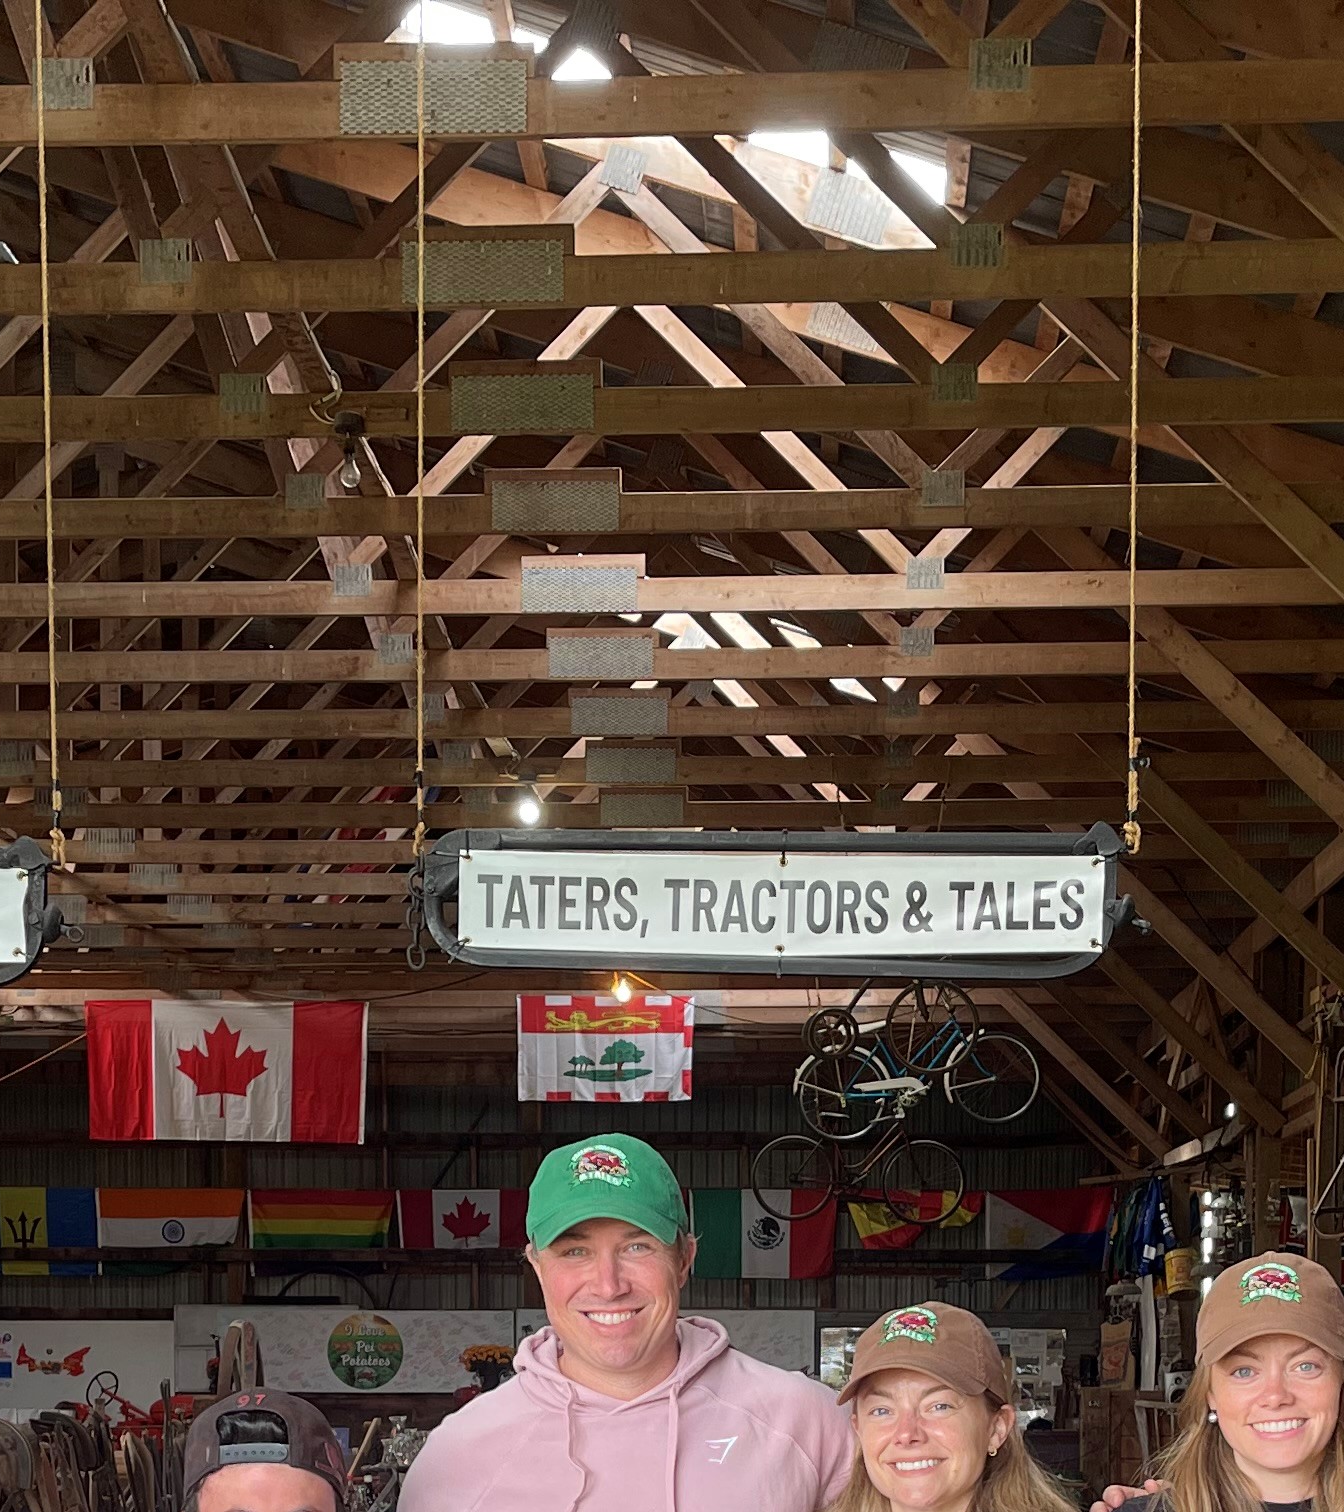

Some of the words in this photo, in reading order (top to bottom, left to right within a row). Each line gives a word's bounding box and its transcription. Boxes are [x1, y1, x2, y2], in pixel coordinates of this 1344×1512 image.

[478, 873, 649, 938] TATERS,
[663, 878, 890, 934] TRACTORS
[902, 879, 934, 932] &
[948, 879, 1086, 931] TALES
[340, 1354, 391, 1366] Potatoes
